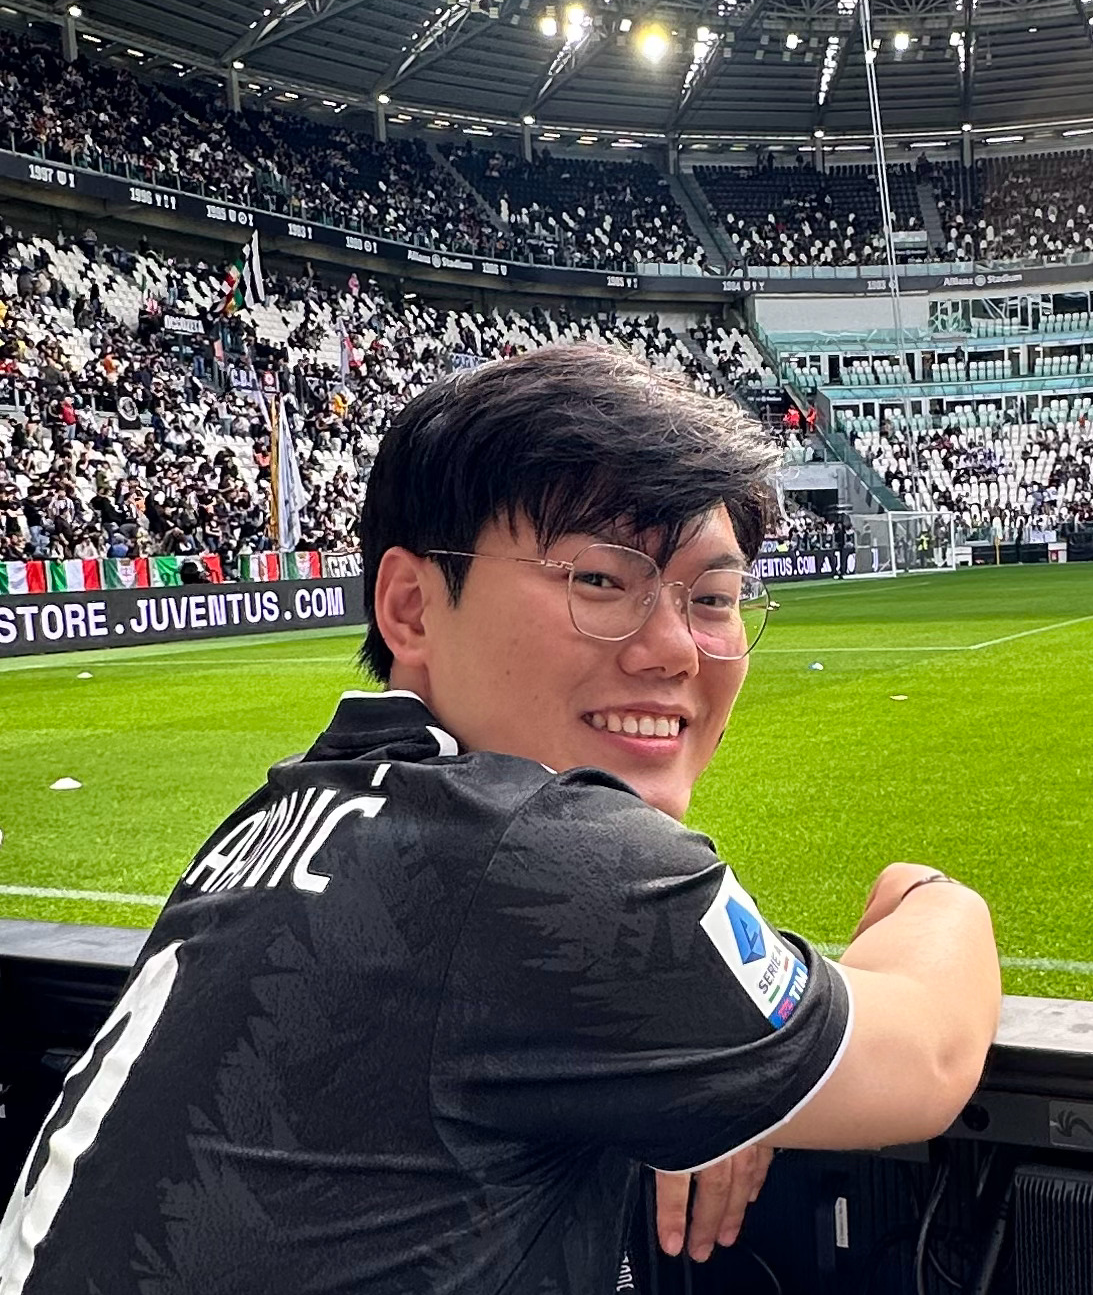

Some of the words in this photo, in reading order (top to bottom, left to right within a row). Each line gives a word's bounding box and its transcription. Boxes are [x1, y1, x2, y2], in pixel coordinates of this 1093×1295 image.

[943, 277, 974, 287] Allianz
[987, 274, 1023, 284] Stadium
[752, 555, 816, 579] VENTUS.COM
[0, 586, 345, 644] STORE.JUVENTUS.COM
[758, 952, 781, 995] SERIE
[788, 966, 808, 1001] TIM
